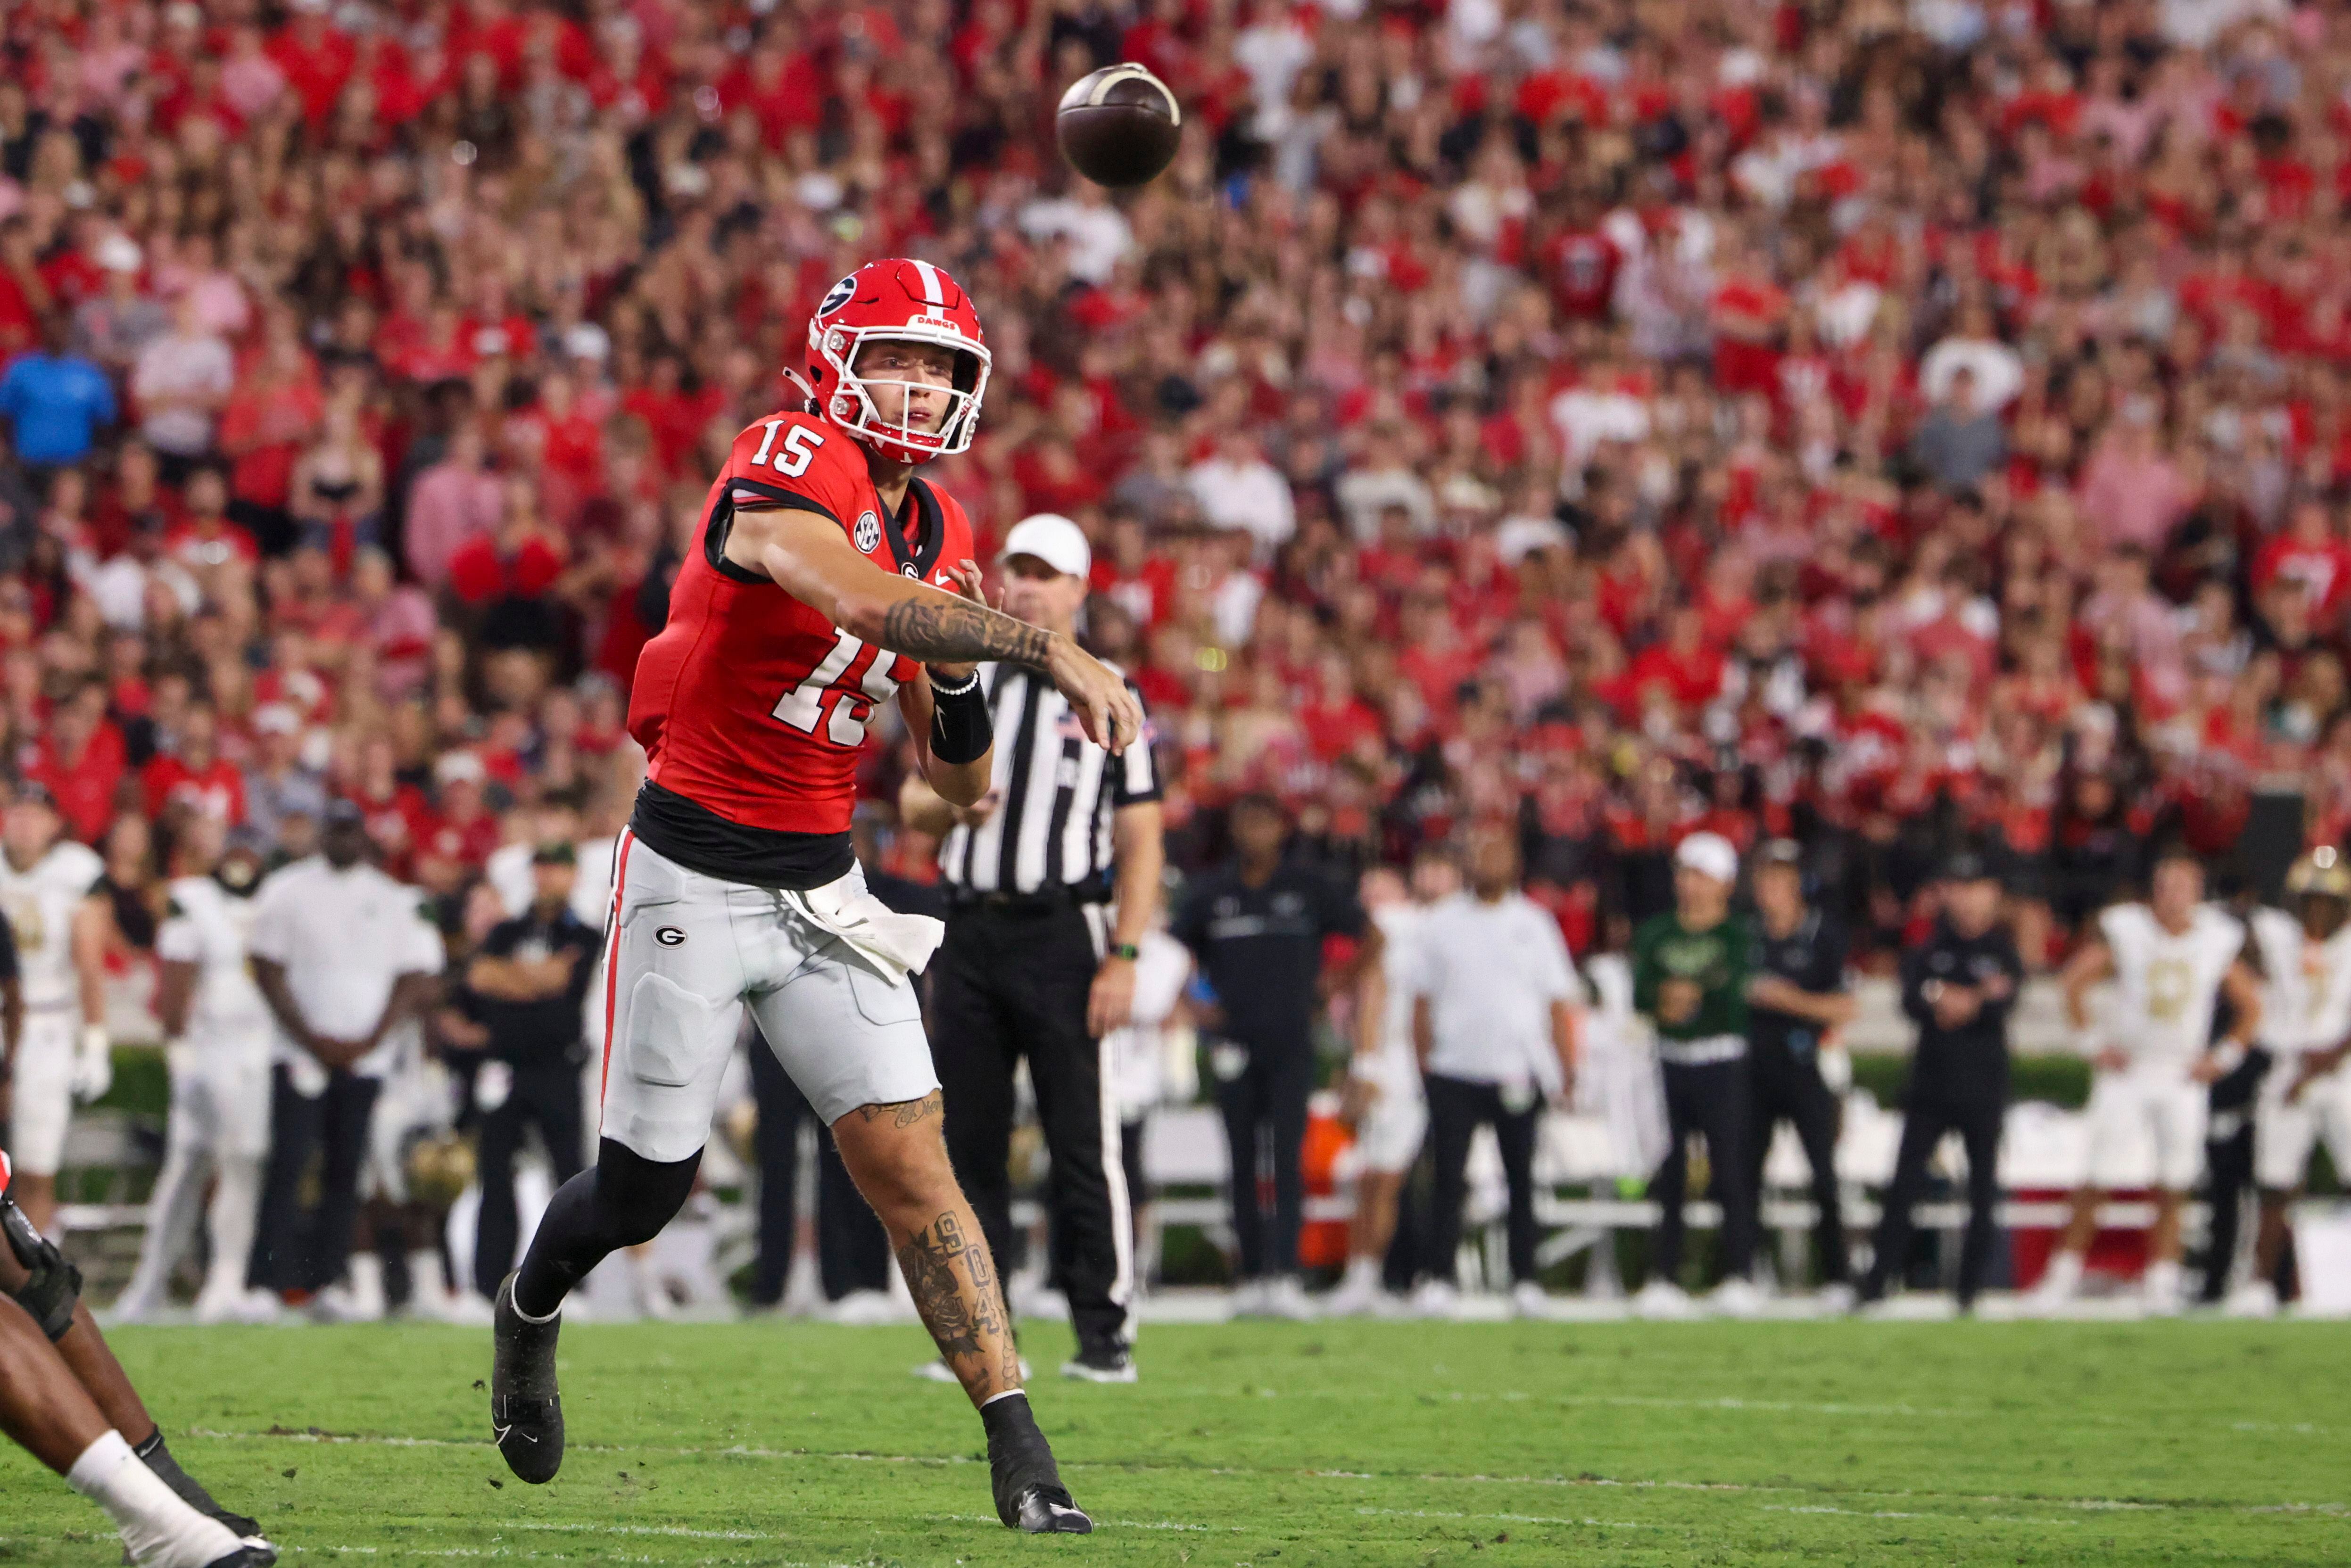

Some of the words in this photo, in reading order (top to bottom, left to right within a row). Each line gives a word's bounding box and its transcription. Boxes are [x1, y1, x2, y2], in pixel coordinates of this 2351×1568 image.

[918, 317, 955, 330] DAWGS
[750, 420, 826, 476] 15
[856, 513, 879, 551] SEC
[655, 927, 685, 946] G
